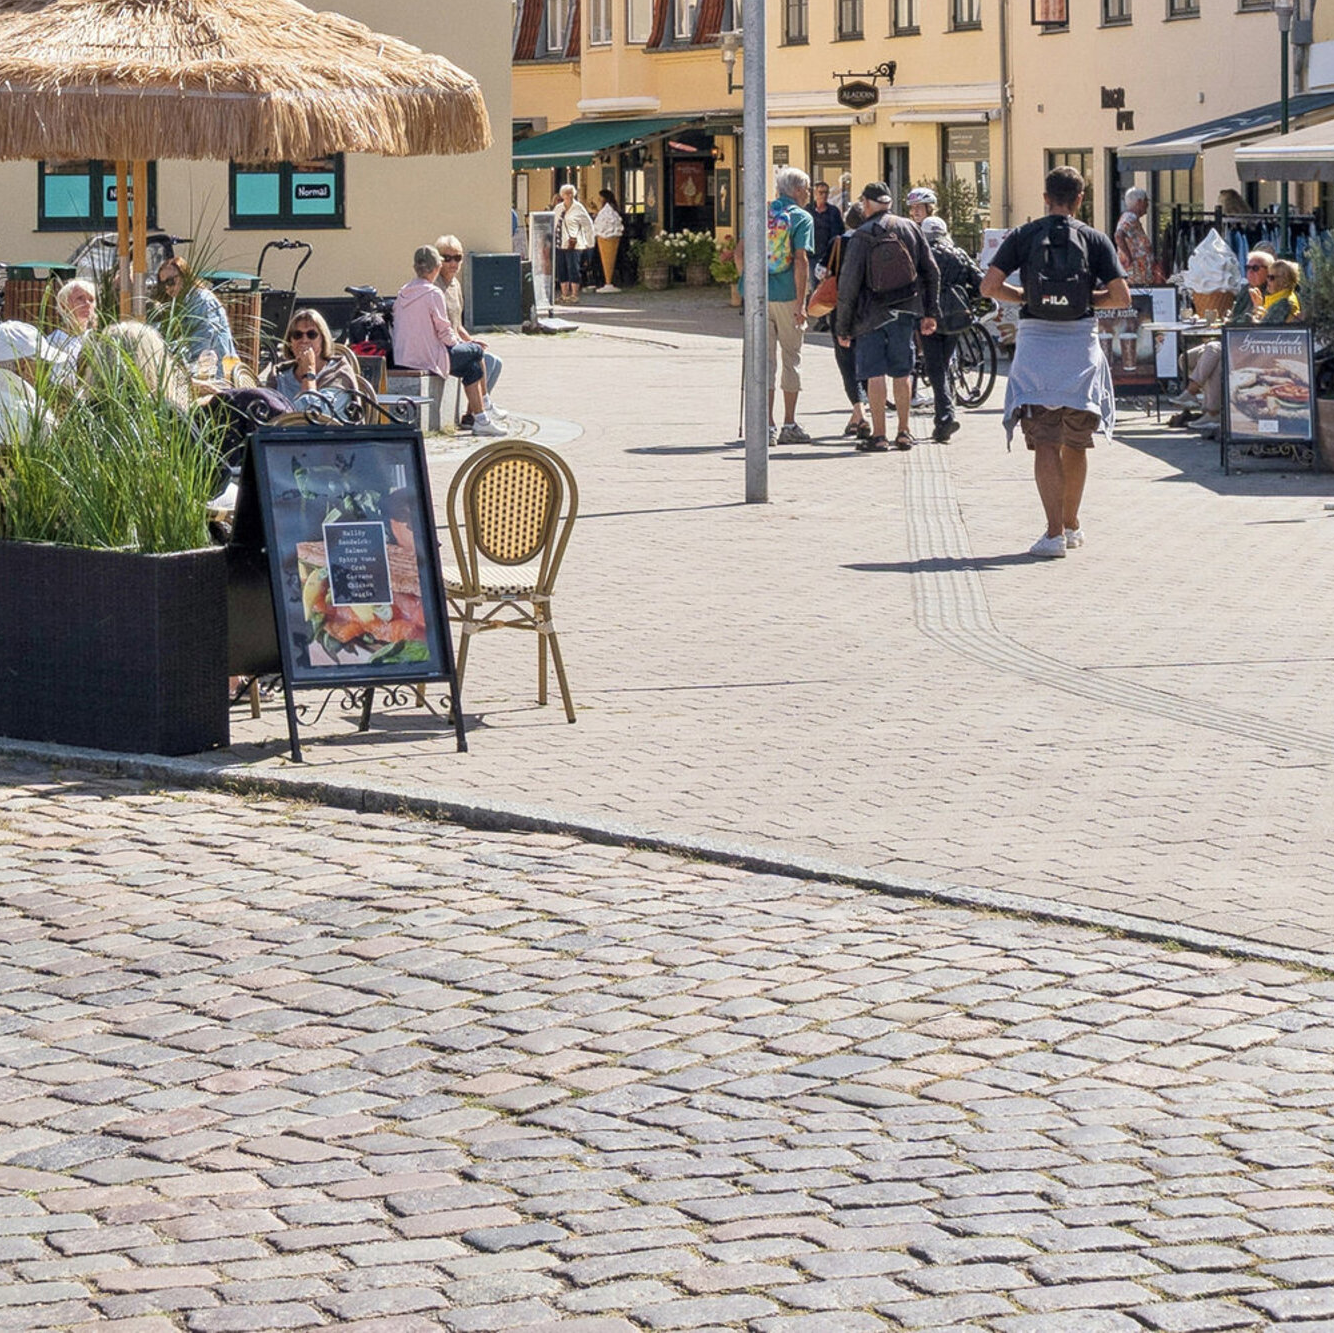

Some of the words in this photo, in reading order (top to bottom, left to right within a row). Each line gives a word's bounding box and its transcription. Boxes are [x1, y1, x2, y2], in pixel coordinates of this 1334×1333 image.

[298, 186, 328, 197] Normal
[1042, 295, 1069, 306] FILA
[1250, 346, 1303, 355] SANDWICHES
